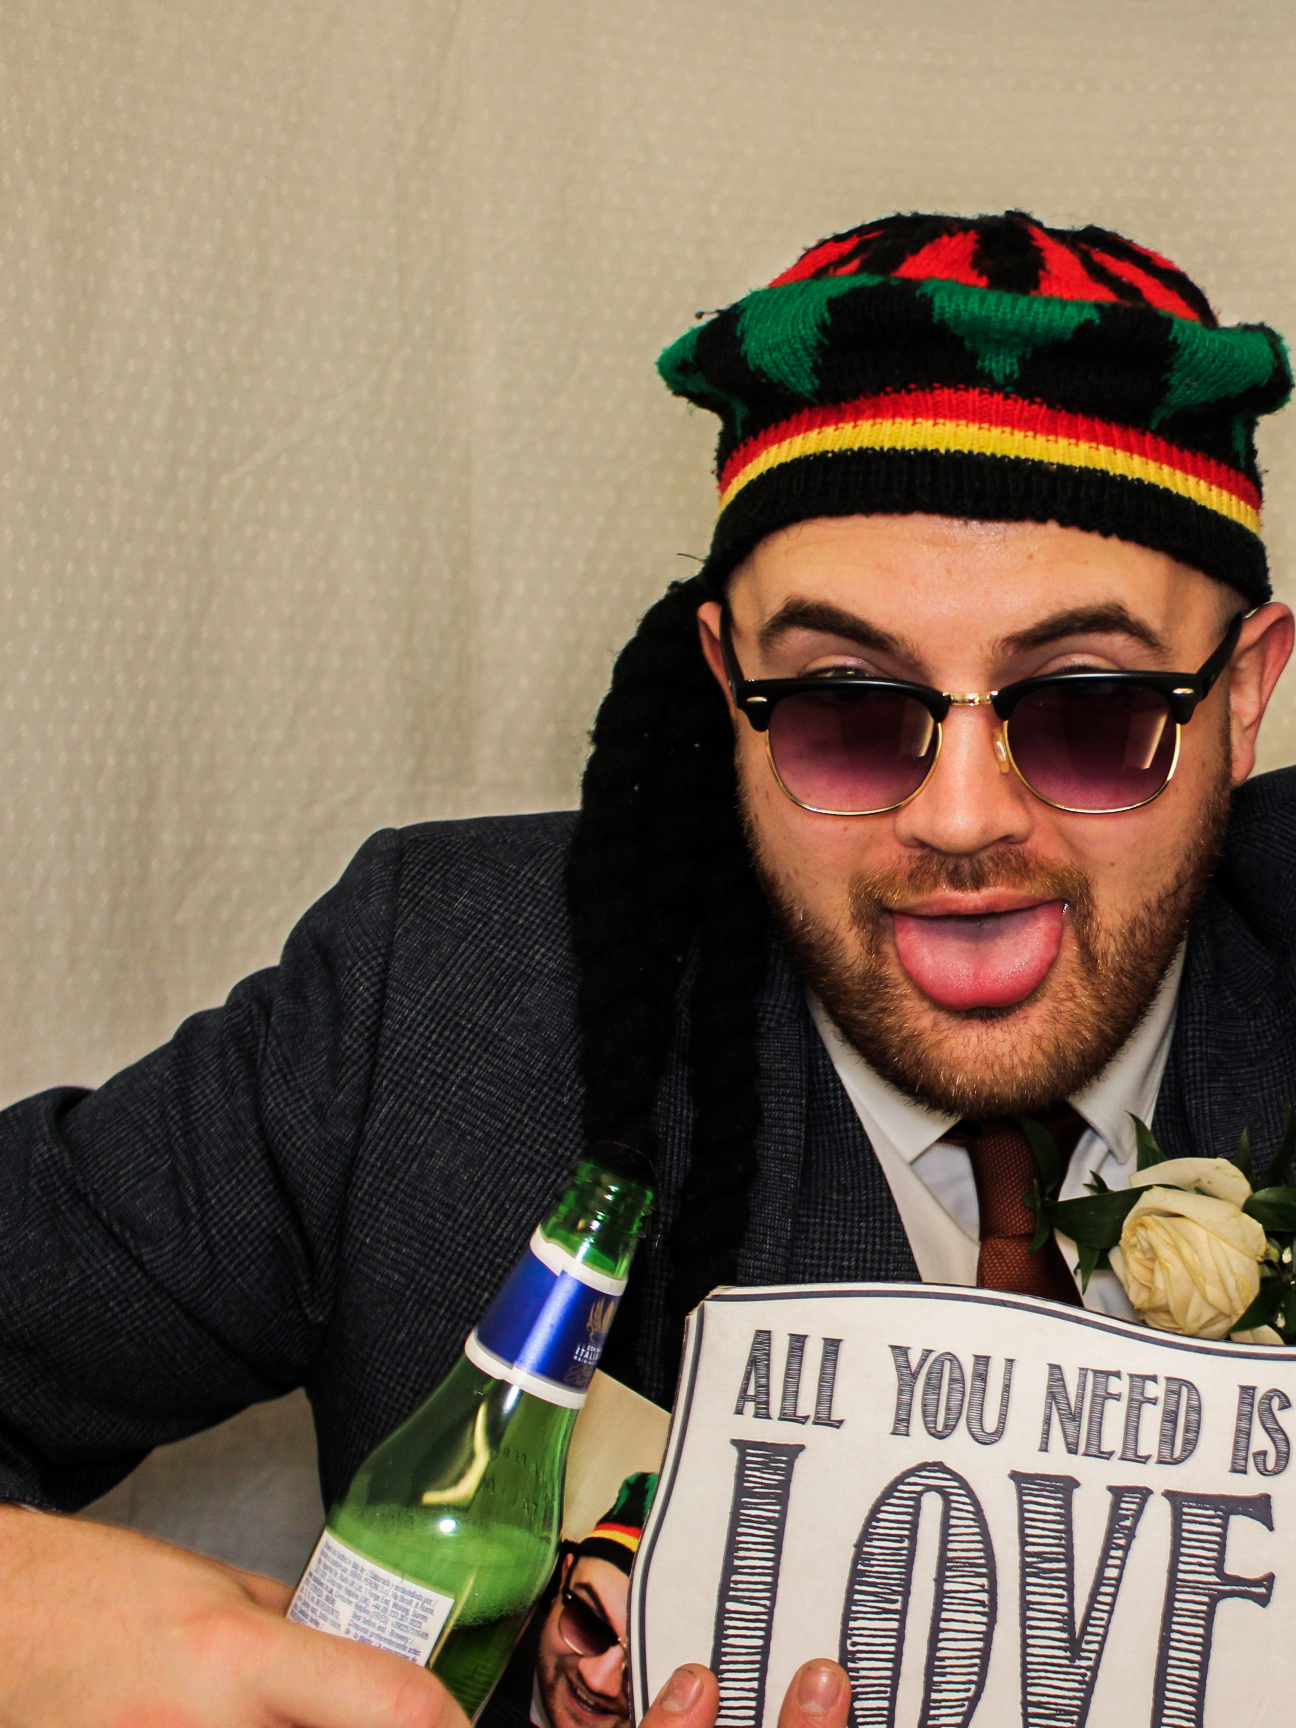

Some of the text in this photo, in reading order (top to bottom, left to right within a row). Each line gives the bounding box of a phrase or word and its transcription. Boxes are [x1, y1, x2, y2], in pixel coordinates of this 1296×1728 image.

[734, 1329, 1291, 1477] ALL YOU NEED IS
[710, 1439, 1275, 1728] LOVE
